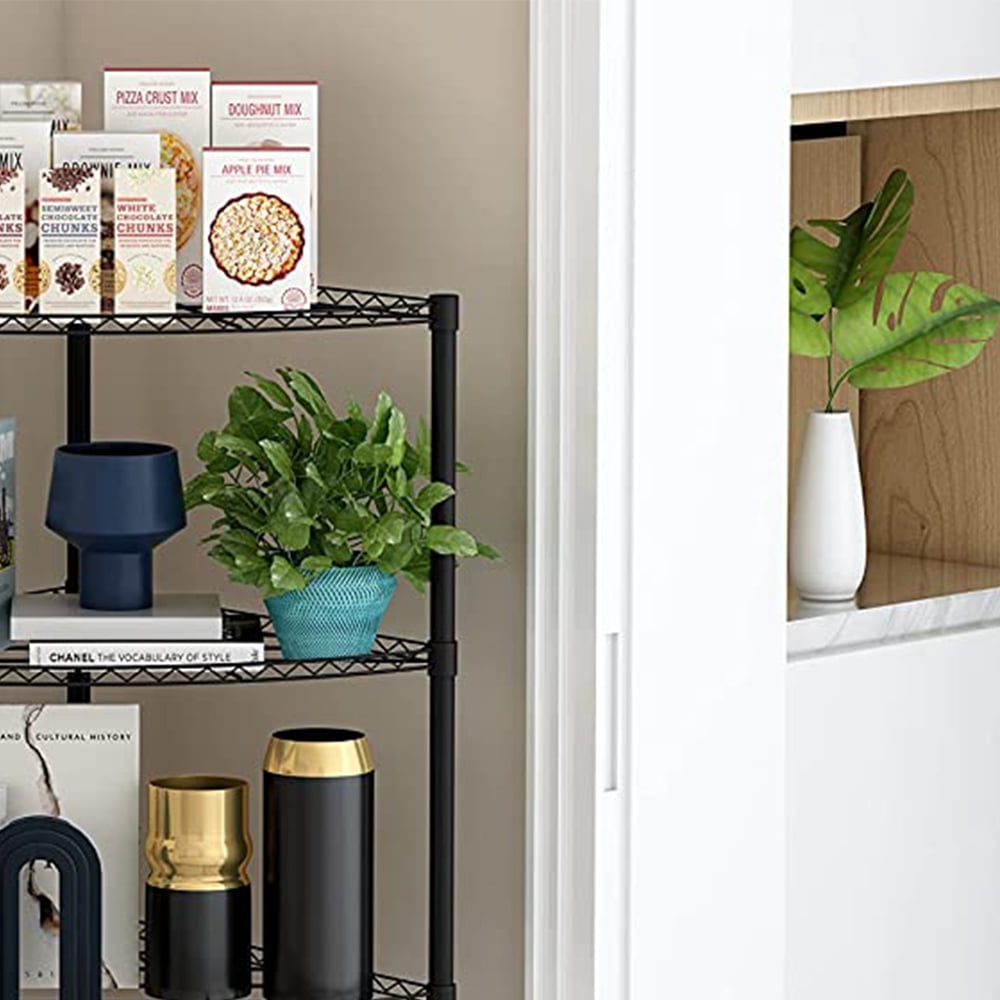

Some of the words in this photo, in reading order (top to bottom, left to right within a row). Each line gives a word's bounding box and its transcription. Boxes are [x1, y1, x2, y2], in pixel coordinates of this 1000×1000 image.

[116, 90, 144, 104] PIZZA
[145, 90, 177, 104] CRUST
[180, 90, 199, 104] MIX
[228, 103, 280, 117] DOUGHNUT
[284, 103, 302, 116] MIX
[0, 151, 23, 171] MIX
[222, 165, 251, 175] APPLE
[255, 165, 270, 175] PIE
[273, 165, 292, 175] MIX
[41, 204, 98, 212] SEMISWEET
[117, 204, 156, 212] WHITE
[41, 223, 98, 233] CHUNKS
[116, 223, 174, 233] CHUNKS
[49, 652, 95, 663] CHANEL
[98, 652, 116, 662] THE
[118, 652, 183, 662] VOCABULARY
[186, 652, 199, 662] OF
[201, 652, 231, 662] STYLE
[0, 733, 21, 741] AND
[35, 733, 86, 741] CULTURAL
[89, 733, 132, 741] HISTORY
